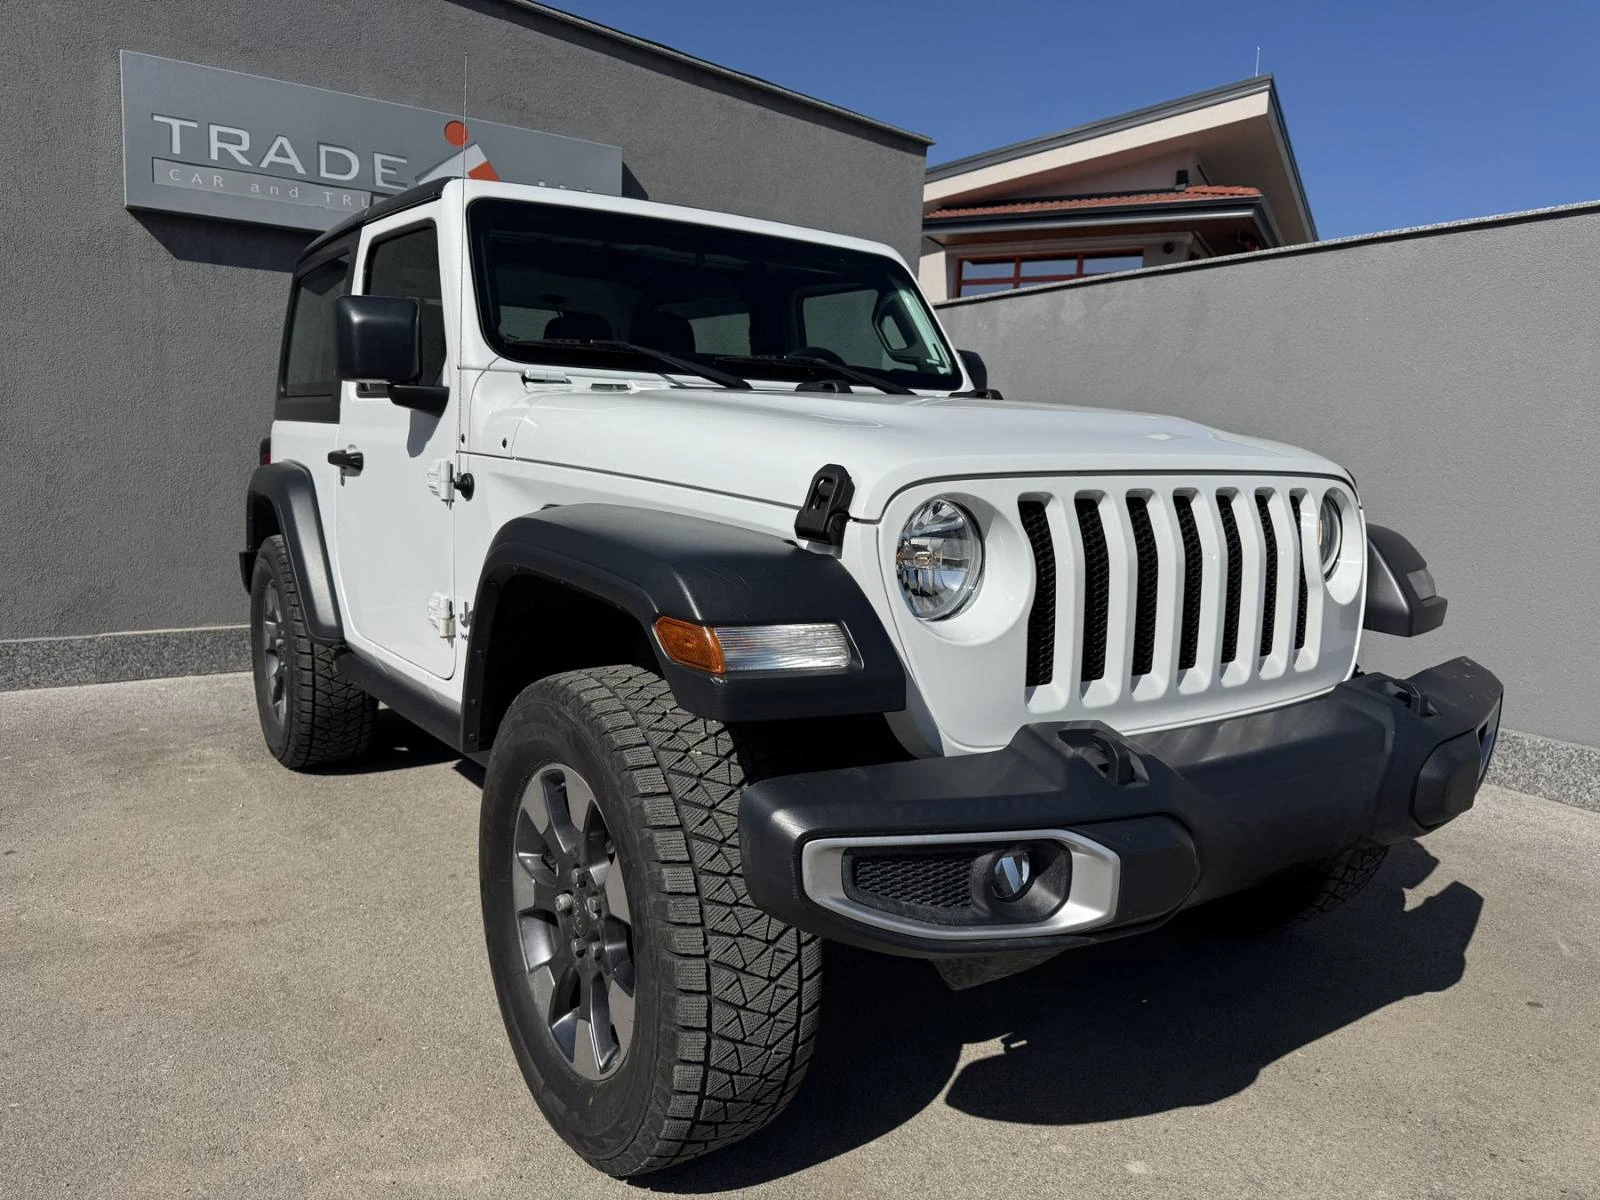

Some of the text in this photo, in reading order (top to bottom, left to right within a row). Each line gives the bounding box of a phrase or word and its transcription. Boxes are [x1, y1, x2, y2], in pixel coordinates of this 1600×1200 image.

[151, 113, 408, 190] TRADE
[169, 168, 370, 210] CAR and TRU
